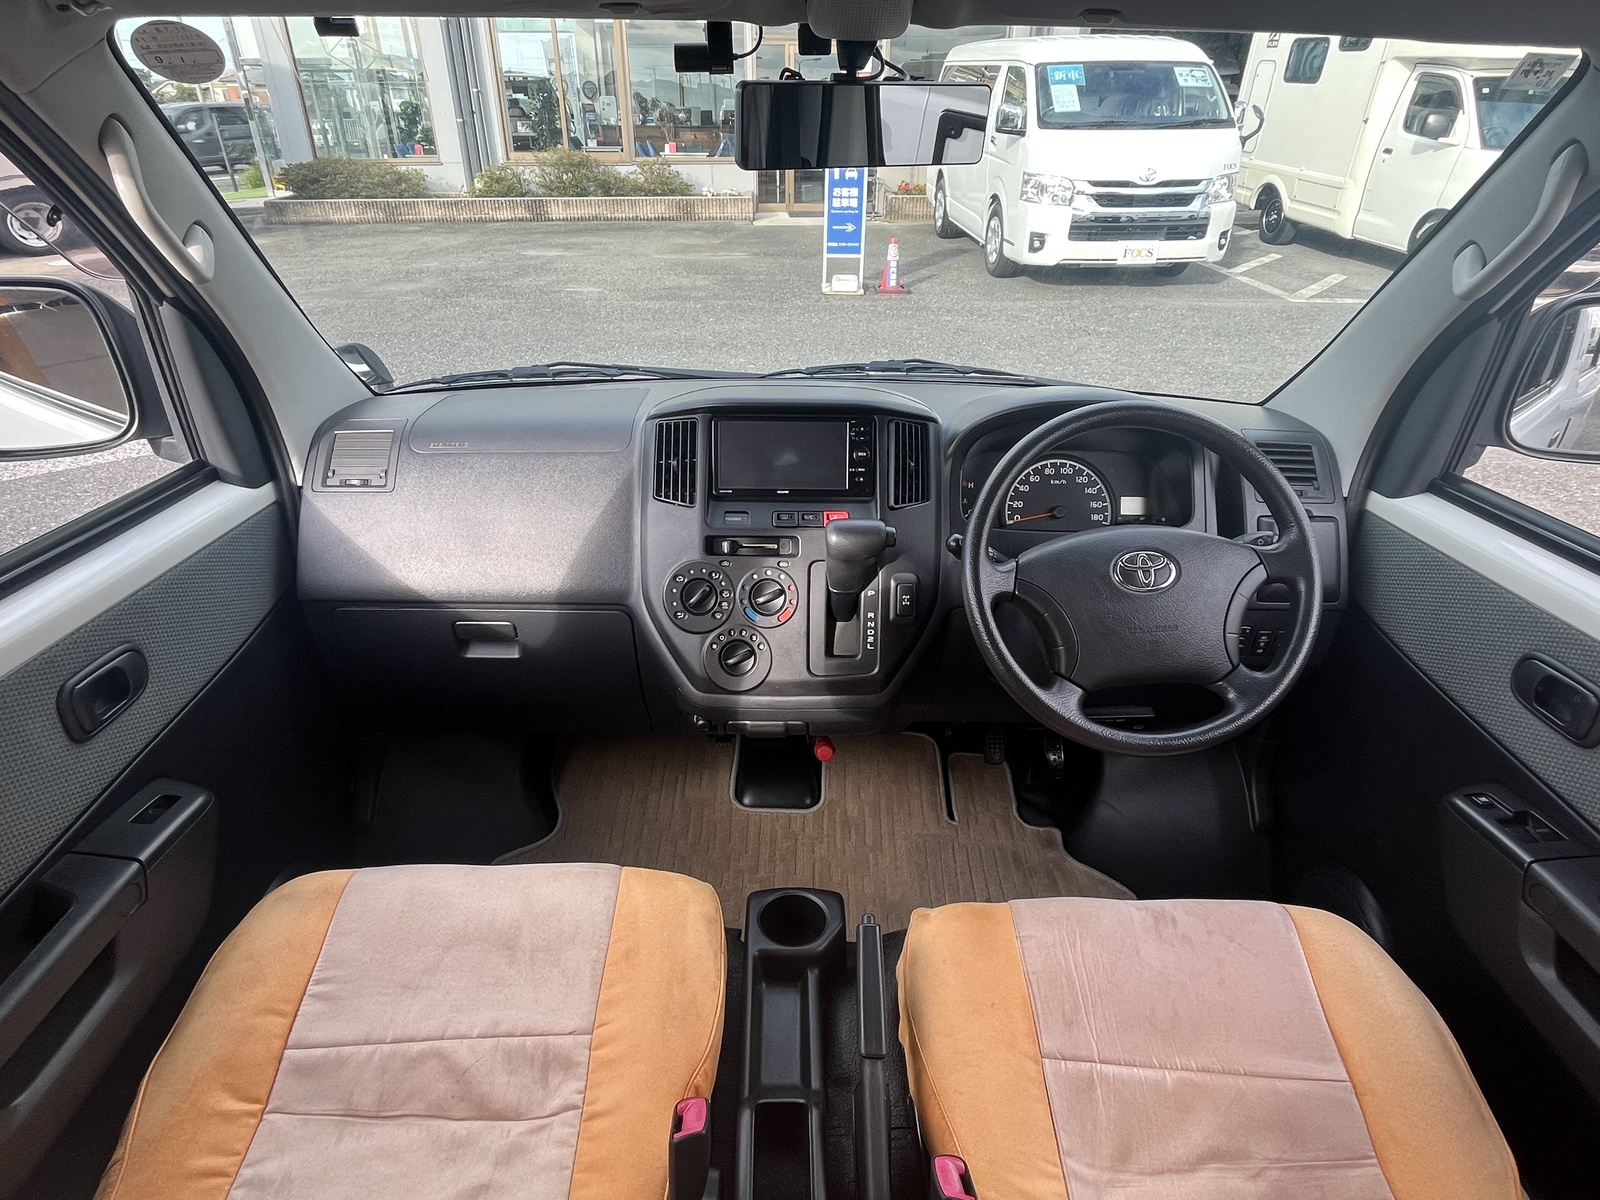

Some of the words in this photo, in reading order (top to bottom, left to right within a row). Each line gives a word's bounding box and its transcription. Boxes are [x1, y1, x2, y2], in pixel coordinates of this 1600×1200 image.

[1223, 162, 1238, 171] FOCS
[832, 187, 859, 197] お客様
[832, 198, 859, 208] 駐車場
[1123, 247, 1154, 259] FOCS
[1044, 467, 1055, 475] 80
[1018, 484, 1029, 492] 40
